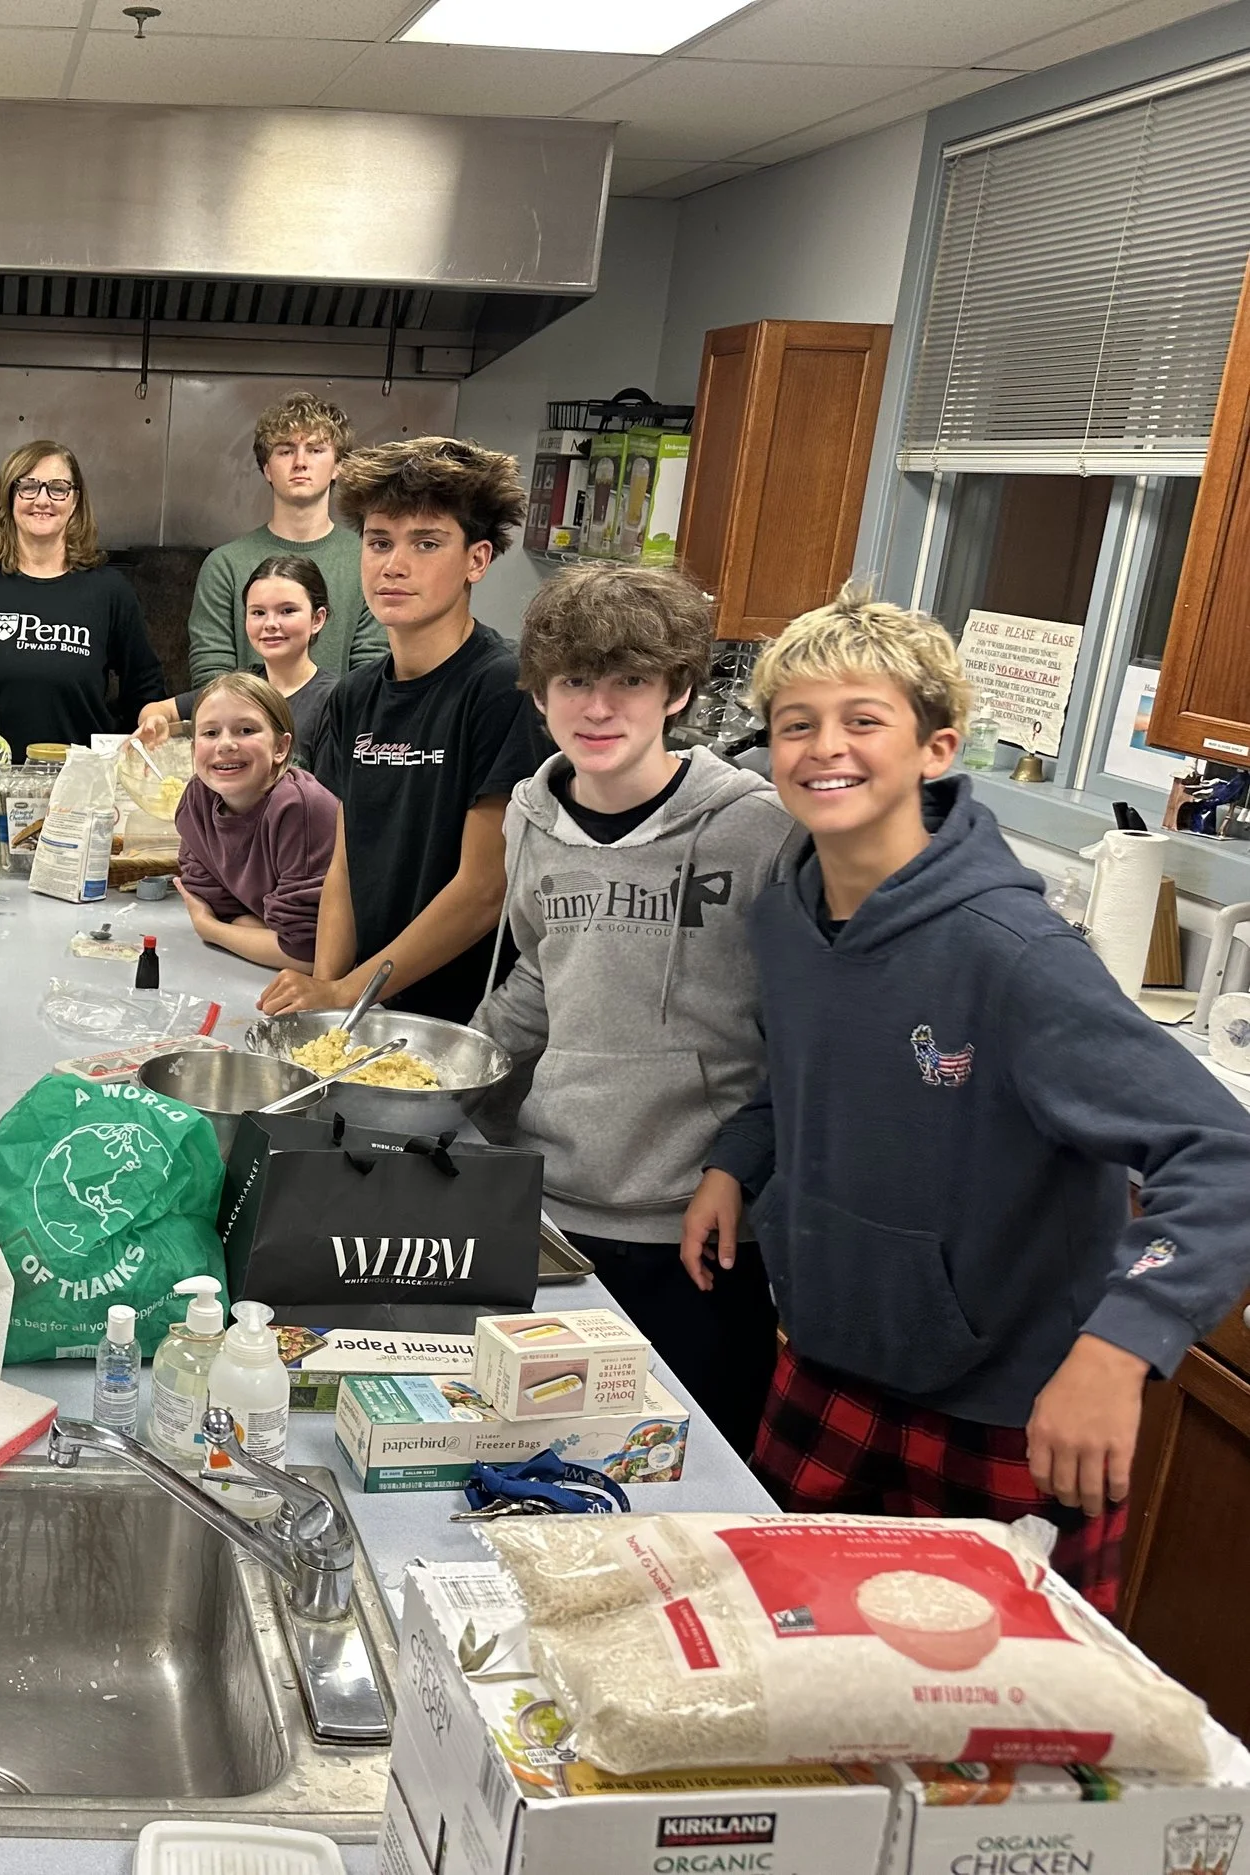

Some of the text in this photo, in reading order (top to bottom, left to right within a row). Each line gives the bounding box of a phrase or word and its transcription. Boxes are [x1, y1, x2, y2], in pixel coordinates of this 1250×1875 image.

[17, 614, 90, 647] Penn
[969, 620, 1075, 647] PLEASE PLEASE PLEASE
[965, 659, 987, 671] THERE
[987, 663, 996, 672] IS
[996, 665, 1007, 674] NO
[1008, 666, 1037, 680] GREASE
[994, 679, 1010, 689] FROM
[1010, 682, 1020, 691] THE
[1015, 694, 1025, 703] THE
[1025, 706, 1041, 717] FROM
[604, 881, 672, 922] Hill
[609, 924, 640, 934] GOLF
[645, 926, 696, 939] COUSE
[75, 1084, 188, 1123] A WORLD
[223, 1158, 260, 1244] BLACKMARKET
[328, 1236, 480, 1279] WHBM
[21, 1244, 145, 1302] OF THANKS
[24, 1296, 166, 1332] bag for all opping
[335, 1338, 397, 1354] Paper
[598, 1370, 636, 1378] UNSALTED
[604, 1363, 632, 1371] BUTTER
[597, 1379, 636, 1390] basket
[594, 1390, 635, 1403] bowl &
[382, 1436, 447, 1453] paperbird
[475, 1440, 541, 1449] Freezer Bags
[749, 1514, 818, 1524] bowl
[753, 1528, 803, 1537] LONG
[809, 1527, 868, 1537] GRAIN
[874, 1529, 936, 1539] WHITE
[846, 1537, 911, 1545] enriched
[626, 1535, 675, 1602] bowl & baske
[410, 1632, 452, 1735] CHICKEN
[410, 1666, 444, 1747] STOCK
[526, 1748, 557, 1758] GLUTEN
[530, 1756, 550, 1764] FREE
[662, 1815, 771, 1836] KIRKLAND
[977, 1834, 1076, 1851] ORGANIC
[653, 1853, 774, 1873] ORGANIC
[950, 1850, 1094, 1875] CHICKEN
